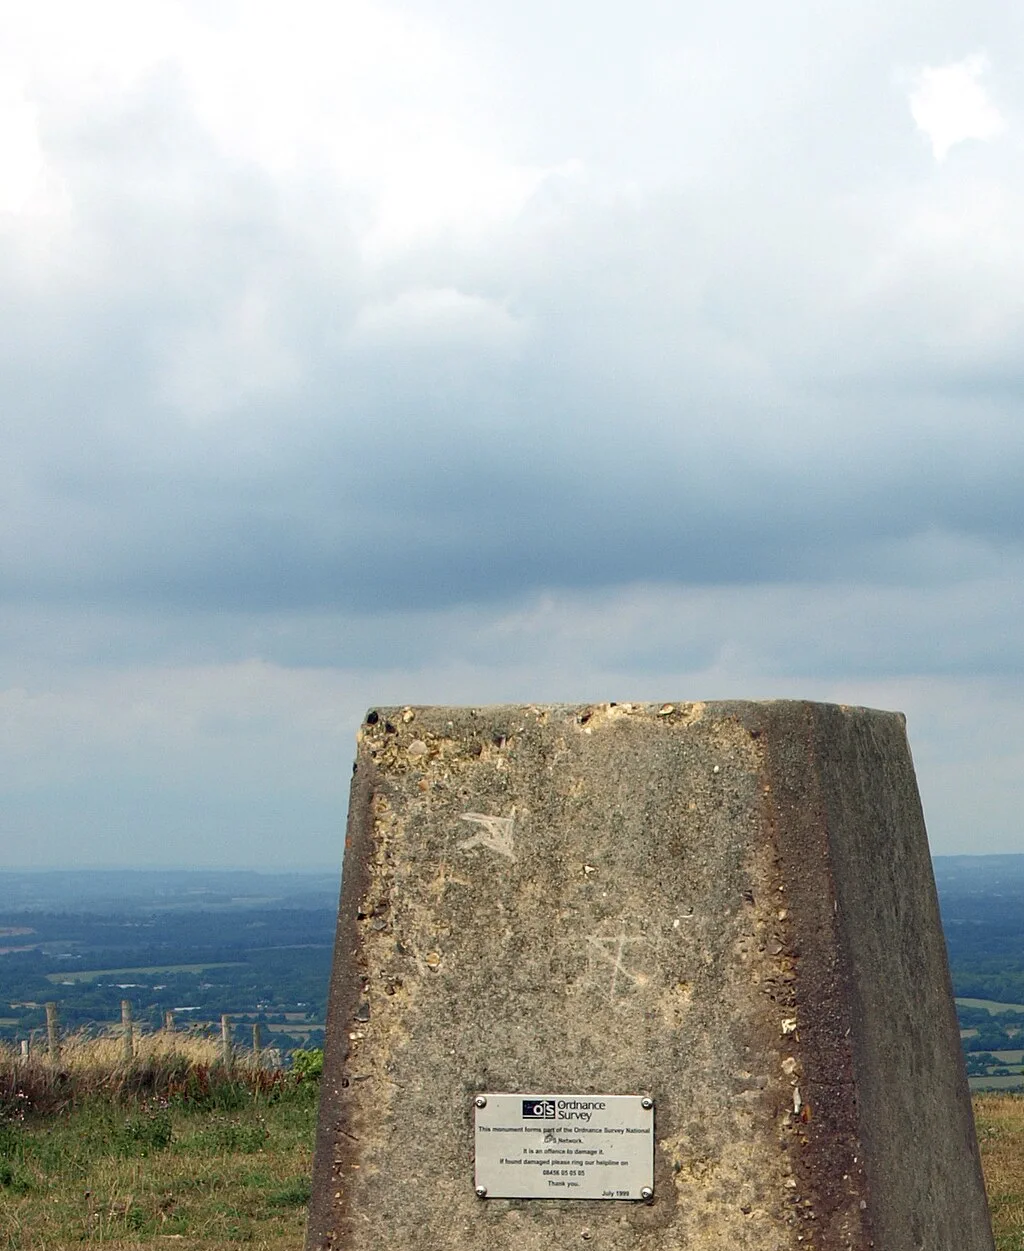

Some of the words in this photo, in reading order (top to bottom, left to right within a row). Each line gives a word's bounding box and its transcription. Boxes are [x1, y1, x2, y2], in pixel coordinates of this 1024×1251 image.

[557, 1100, 606, 1110] Ordnance
[557, 1111, 592, 1122] Survey
[604, 1127, 624, 1135] Survey
